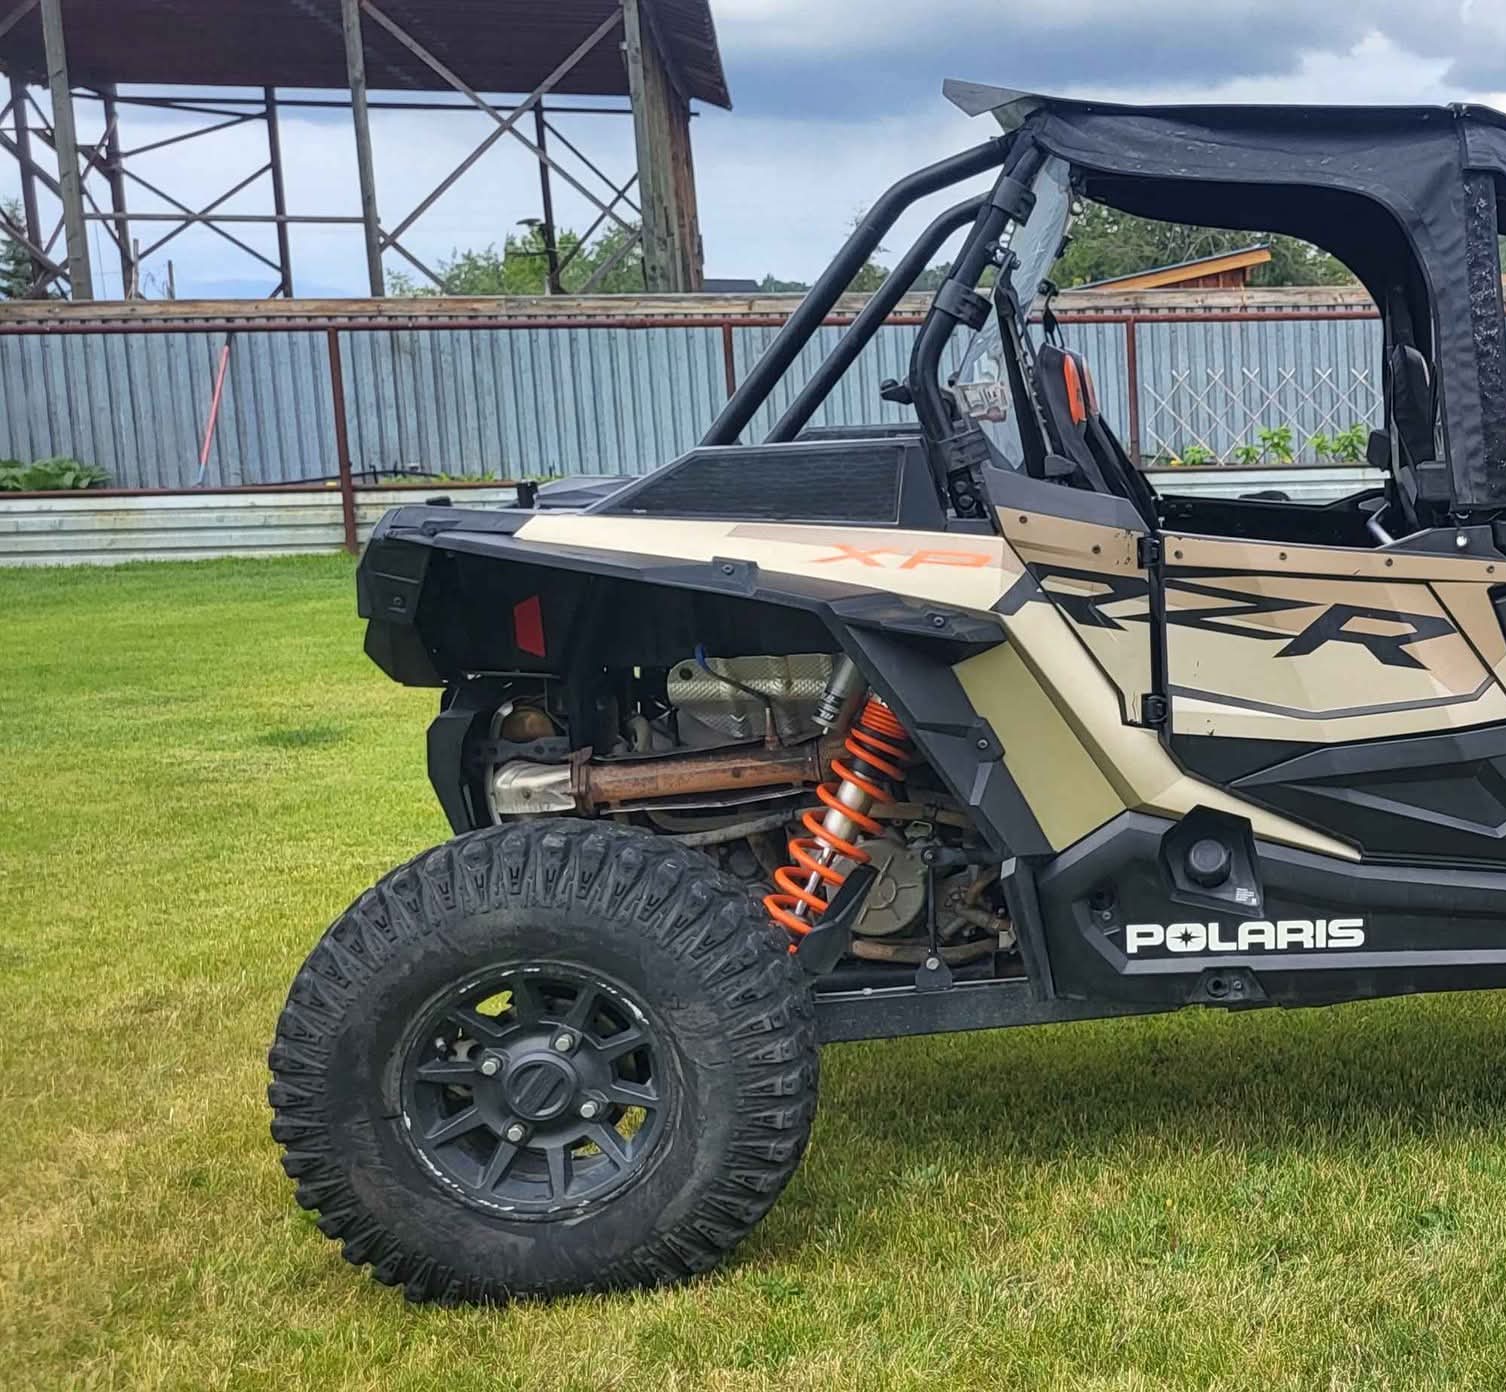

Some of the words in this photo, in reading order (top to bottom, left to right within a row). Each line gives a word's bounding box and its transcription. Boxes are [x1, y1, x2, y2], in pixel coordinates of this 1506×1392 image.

[809, 543, 992, 570] XP
[989, 561, 1457, 670] RZR
[1126, 918, 1365, 954] POLARIS
